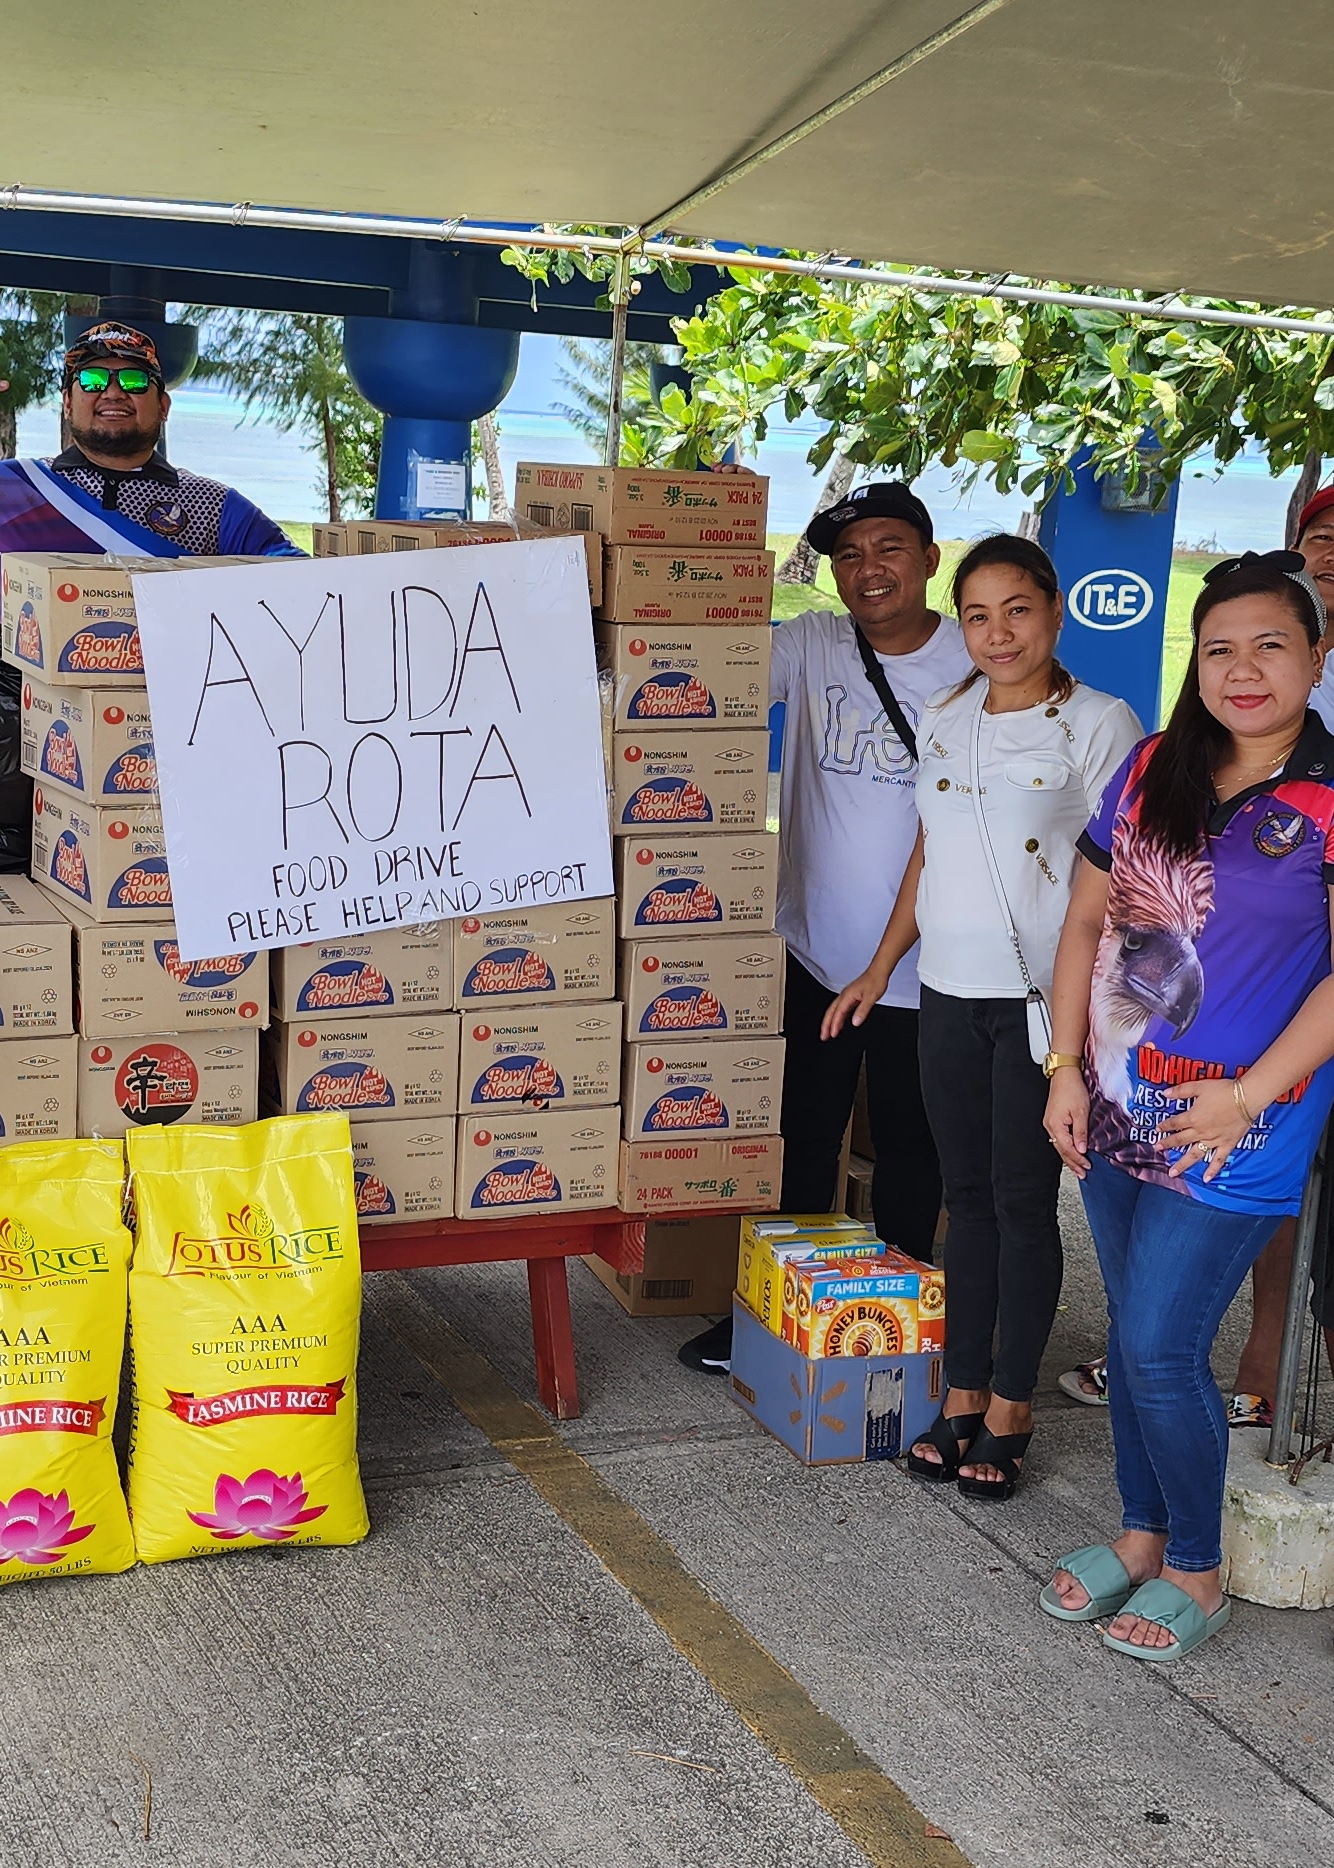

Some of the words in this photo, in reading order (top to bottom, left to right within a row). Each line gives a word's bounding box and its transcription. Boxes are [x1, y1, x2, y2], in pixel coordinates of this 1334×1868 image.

[661, 485, 718, 507] サッポロ一番
[727, 490, 749, 505] PACK
[752, 491, 763, 504] 24
[743, 519, 757, 527] BEST
[627, 529, 665, 540] ORIGINAL
[699, 530, 733, 542] 00001
[734, 532, 757, 541] 76186
[666, 560, 724, 582] サッポロ一番
[732, 563, 754, 578] PACK
[757, 564, 768, 577] 24
[748, 596, 763, 604] BEST
[1083, 583, 1140, 617] IT&E
[633, 608, 672, 619] ORIGINAL
[705, 607, 740, 619] 00001
[741, 609, 764, 618] 76186
[75, 633, 124, 654] Bowl
[649, 643, 692, 651] NONGSHIM
[70, 651, 137, 670] Noodle
[188, 582, 521, 745] AYUDA
[642, 683, 685, 700] Bowl
[637, 700, 693, 716] Noodle
[643, 751, 688, 759] NONGSHIM
[278, 724, 532, 851] ROTA
[955, 783, 987, 796] VERCE
[637, 788, 680, 805] Bowl
[632, 804, 687, 821] Noodle
[272, 855, 349, 898] FOOD
[376, 841, 464, 886] DRIVE
[1035, 852, 1060, 887] VERSACE
[228, 902, 320, 942] PLEASE
[343, 888, 413, 929] HELP
[419, 880, 481, 918] AND
[489, 862, 588, 905] SUPPORT
[193, 955, 244, 976] Bowl
[313, 972, 358, 991] Bowl
[307, 990, 366, 1007] Noodle
[185, 1007, 236, 1017] NONGSHIM
[320, 1032, 368, 1041] NONGSHIM
[1138, 1045, 1165, 1084] NO
[124, 1054, 168, 1113] 辛
[164, 1080, 191, 1092] 라면
[313, 1072, 359, 1091] Bowl
[307, 1089, 366, 1107] Noodle
[493, 1131, 538, 1141] NONGSHIM
[639, 1151, 662, 1160] 76186
[664, 1147, 698, 1160] 00001
[731, 1144, 769, 1155] ORIGINAL
[486, 1170, 529, 1189] Bowl
[684, 1177, 740, 1198] サッポロ一番
[483, 1187, 536, 1205] Noodle
[637, 1188, 647, 1200] 24
[651, 1187, 673, 1200] PACK
[24, 1243, 110, 1276] RICE
[162, 1231, 262, 1277] LOTUS
[264, 1226, 343, 1264] RICE
[257, 1272, 268, 1280] of
[275, 1266, 323, 1280] Vietnam
[20, 1284, 32, 1292] of
[39, 1278, 88, 1288] Vietnam
[826, 1280, 874, 1297] FAMILY
[876, 1278, 905, 1292] SIZE
[817, 1298, 837, 1314] Post
[230, 1314, 287, 1335] AAA
[830, 1310, 855, 1356] HONEY
[857, 1306, 898, 1352] BUNCHES
[192, 1341, 245, 1355] SUPER
[250, 1335, 328, 1352] PREMIUM
[14, 1349, 91, 1366] PREMIUM
[227, 1356, 301, 1374] QUALITY
[187, 1391, 282, 1423] JASMINE
[286, 1391, 330, 1408] RICE
[50, 1407, 93, 1427] RICE
[48, 1565, 65, 1577] 50
[66, 1557, 92, 1573] LBS
